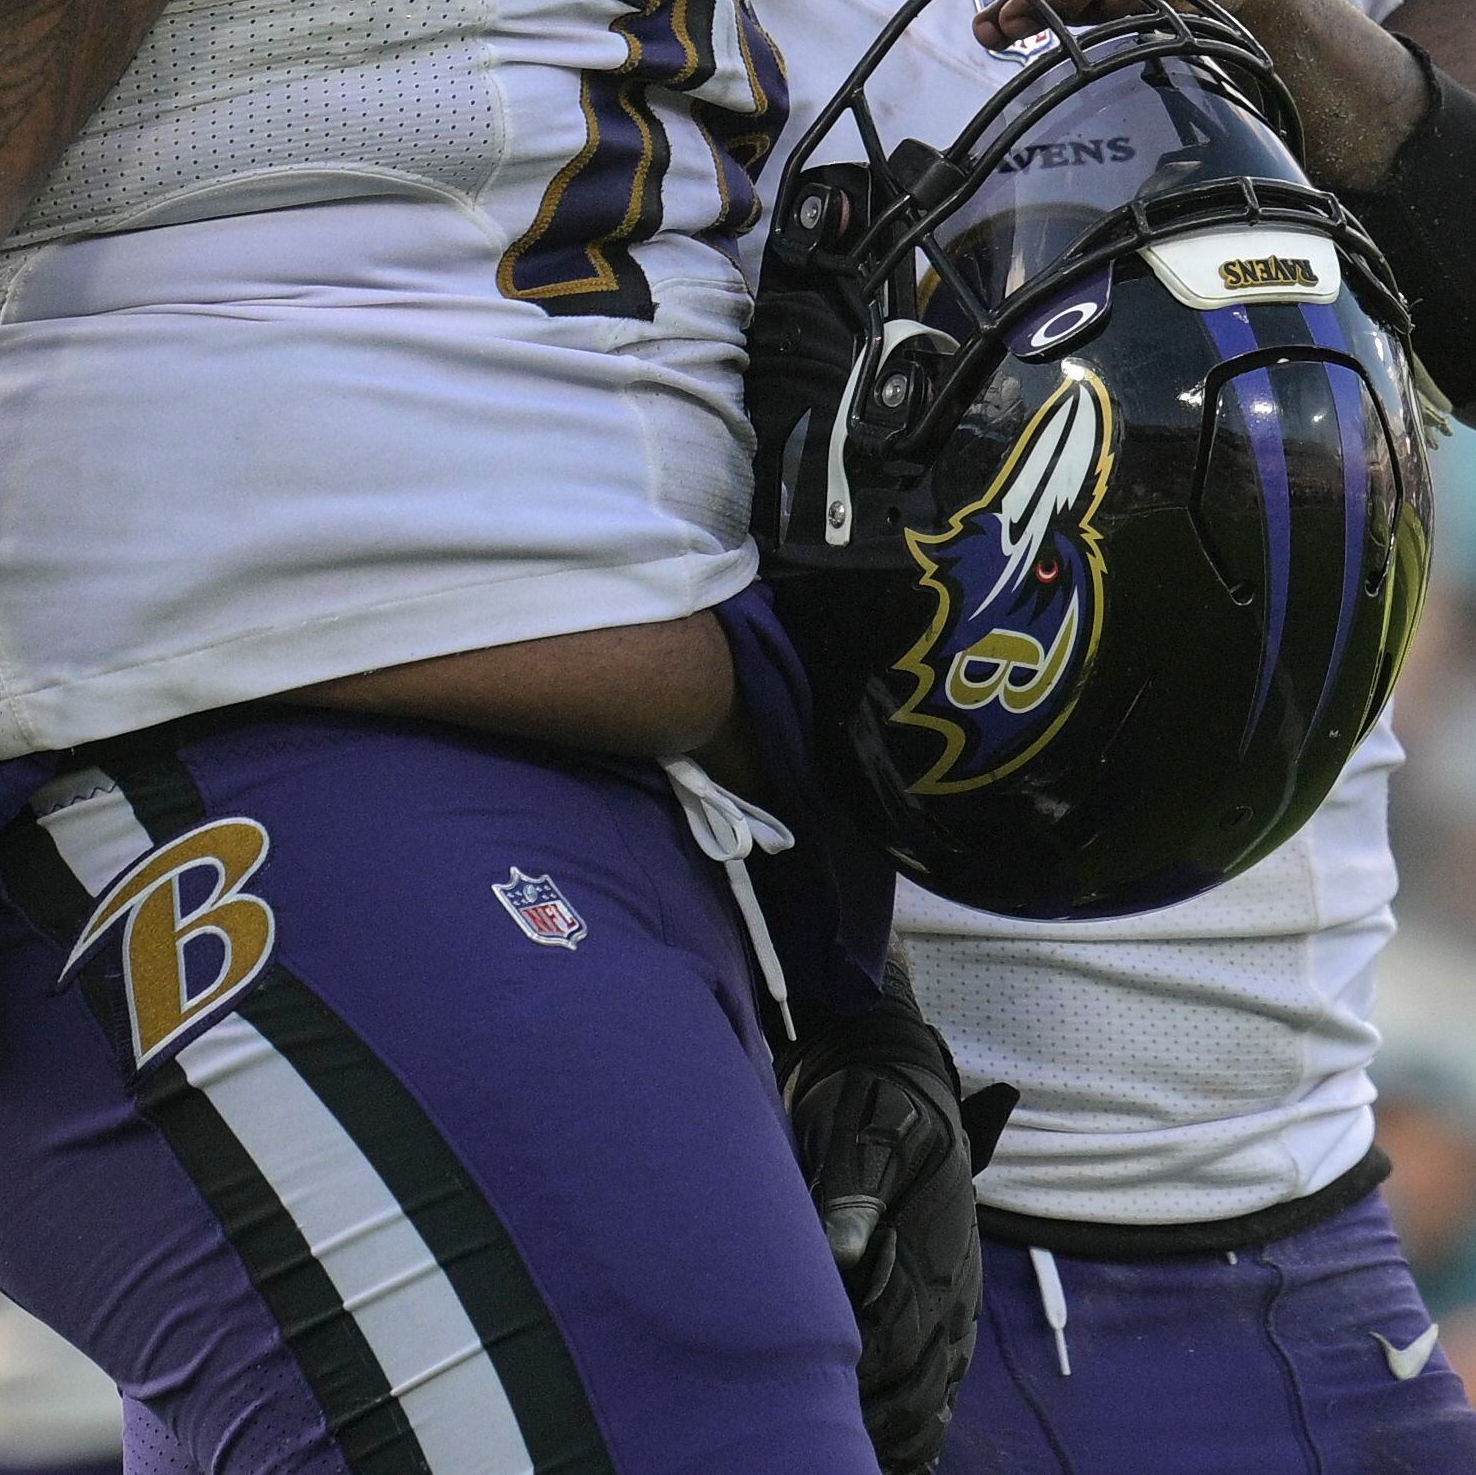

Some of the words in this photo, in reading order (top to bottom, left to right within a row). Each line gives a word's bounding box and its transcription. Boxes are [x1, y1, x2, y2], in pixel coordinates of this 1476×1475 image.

[1218, 254, 1319, 290] RAVENS
[523, 903, 578, 935] NFL
[57, 816, 276, 1070] B
